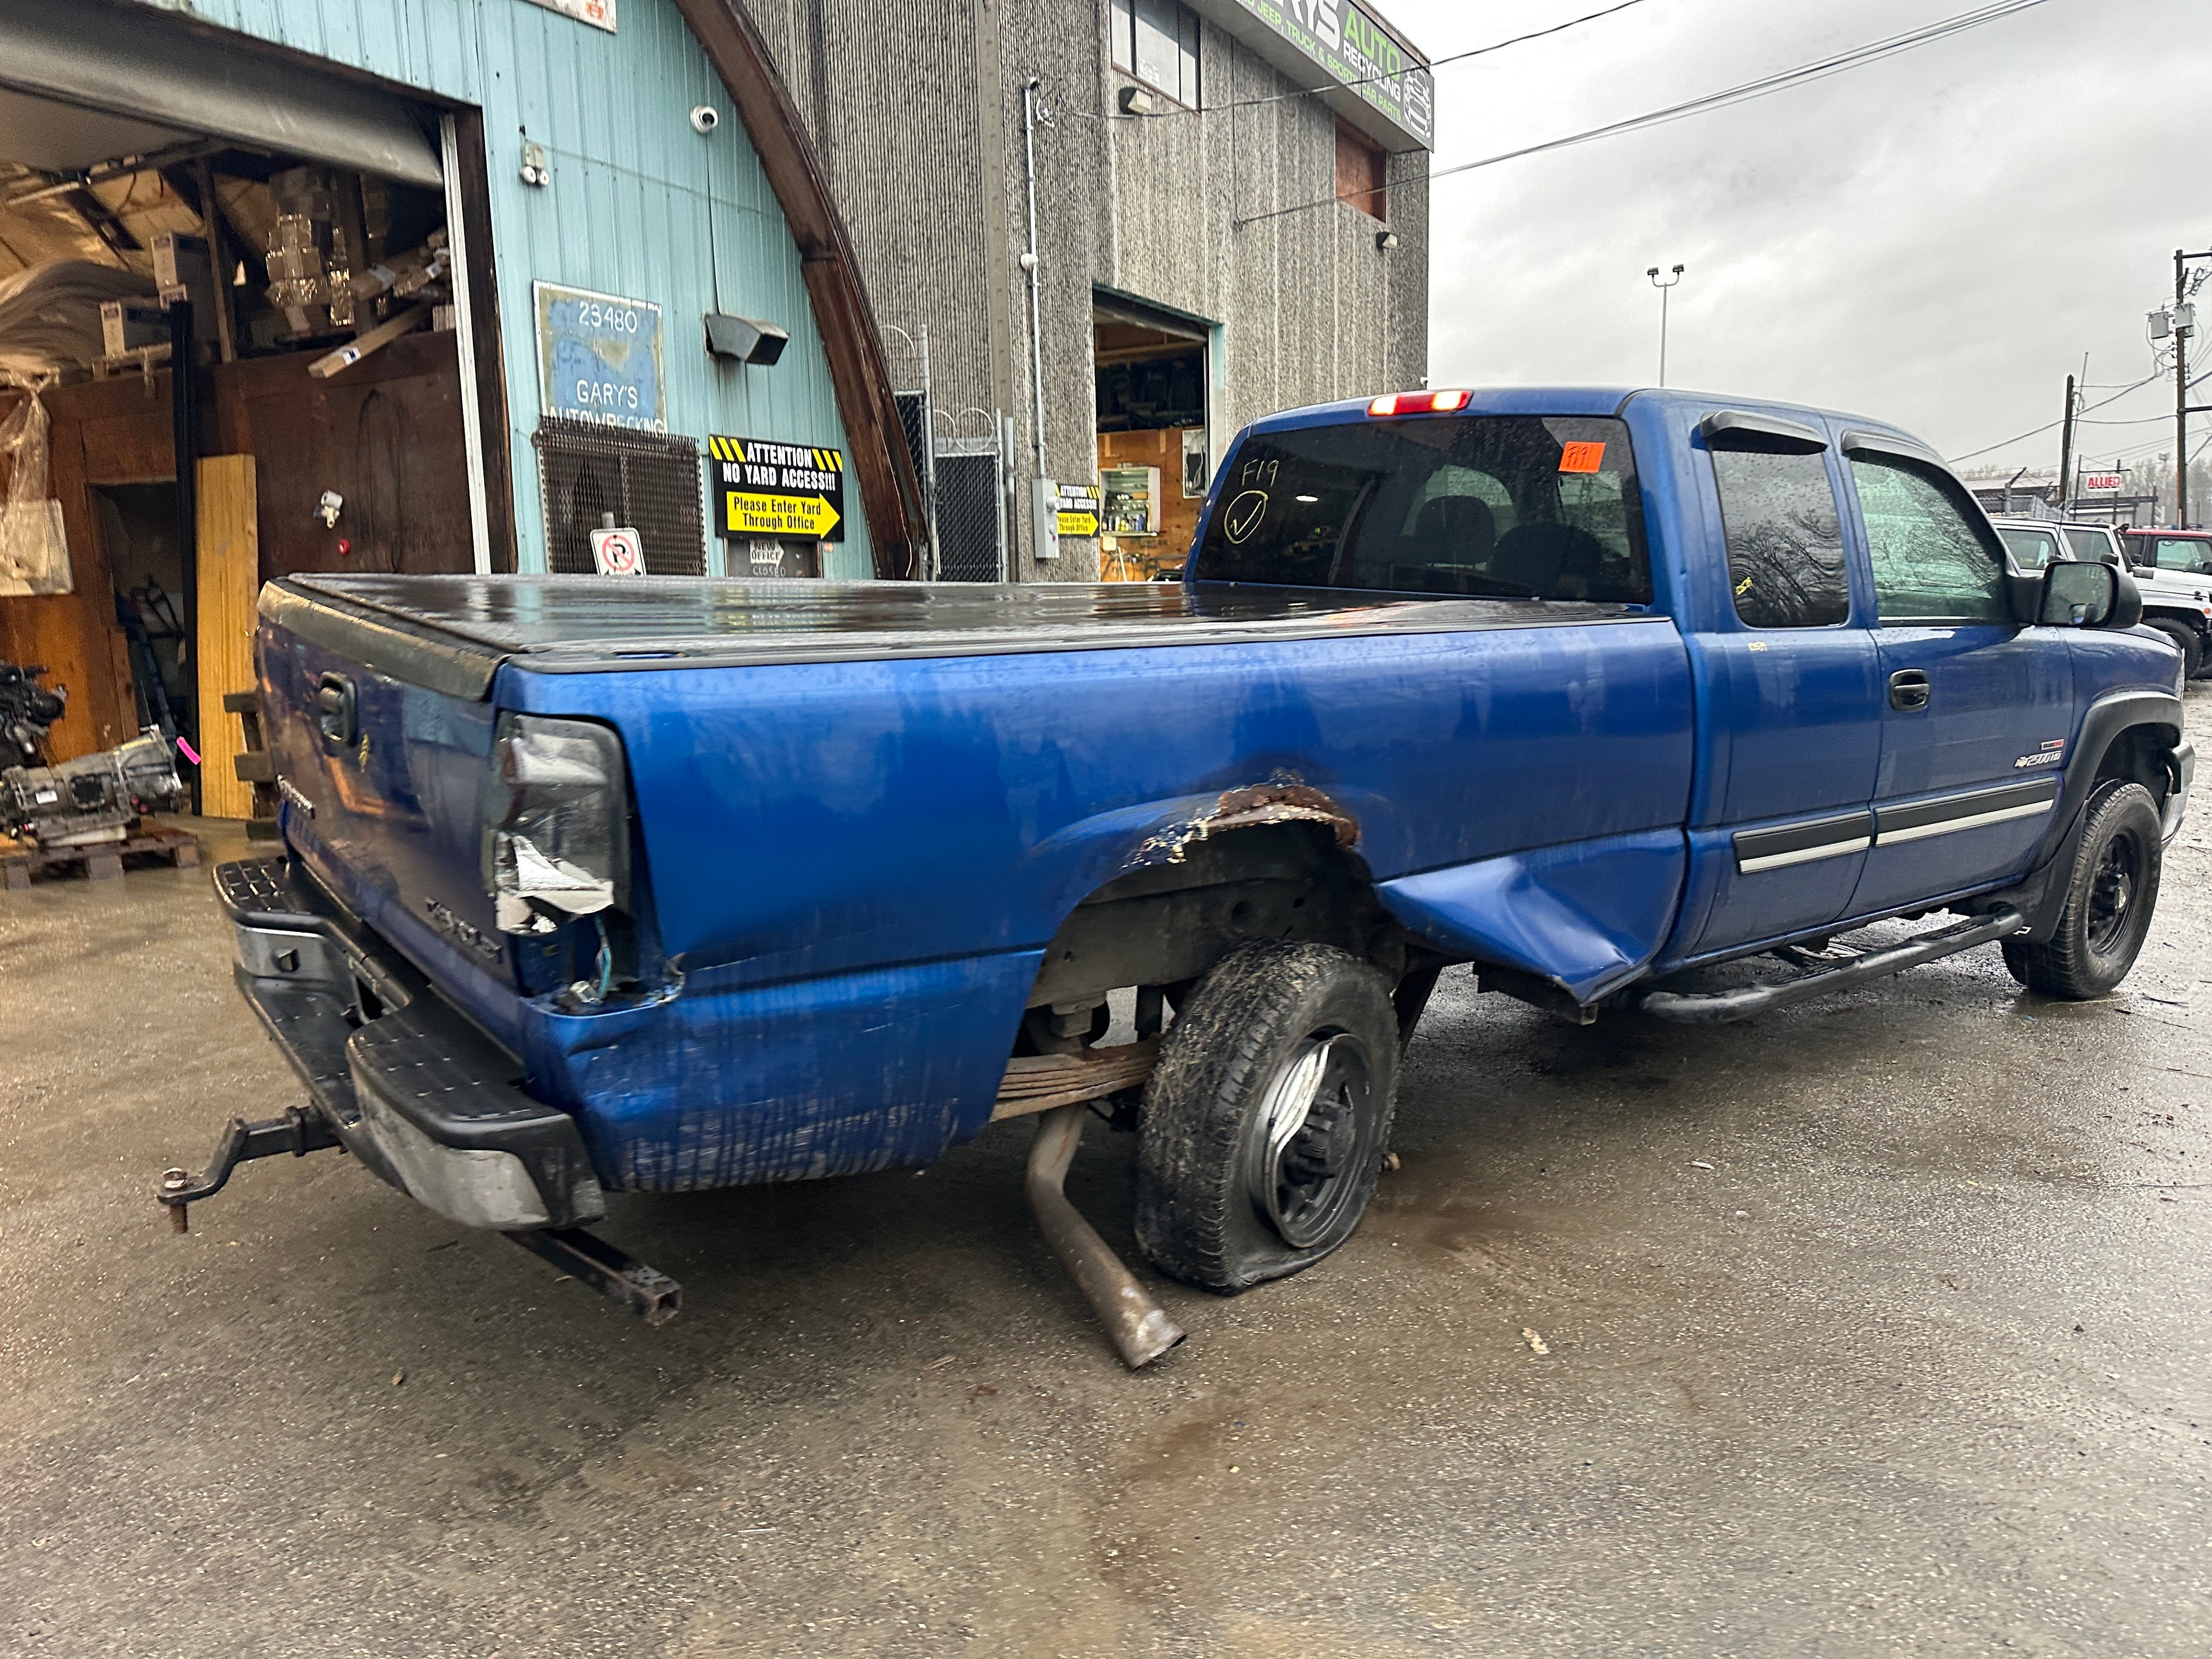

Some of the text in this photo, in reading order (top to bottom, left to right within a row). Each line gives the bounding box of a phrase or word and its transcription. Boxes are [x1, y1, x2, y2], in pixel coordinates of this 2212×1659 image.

[1344, 7, 1401, 81] AUTO
[1286, 19, 1316, 56] TRUCK
[1318, 46, 1325, 63] &
[1327, 54, 1359, 88] SPORTS
[1362, 82, 1377, 103] CAR
[1378, 94, 1401, 121] PARTS
[1343, 39, 1401, 103] RECYCLING
[579, 301, 638, 334] 23480
[577, 380, 638, 409] GARY'S
[747, 442, 812, 468] ATTENTION
[722, 462, 835, 491] NO YARD ACCESS!!!
[1242, 459, 1279, 488] F19
[2088, 476, 2120, 487] ALLIED
[1060, 485, 1087, 498] ATTENTION
[734, 497, 821, 516] Please Enter Yard
[743, 513, 815, 530] Through Office
